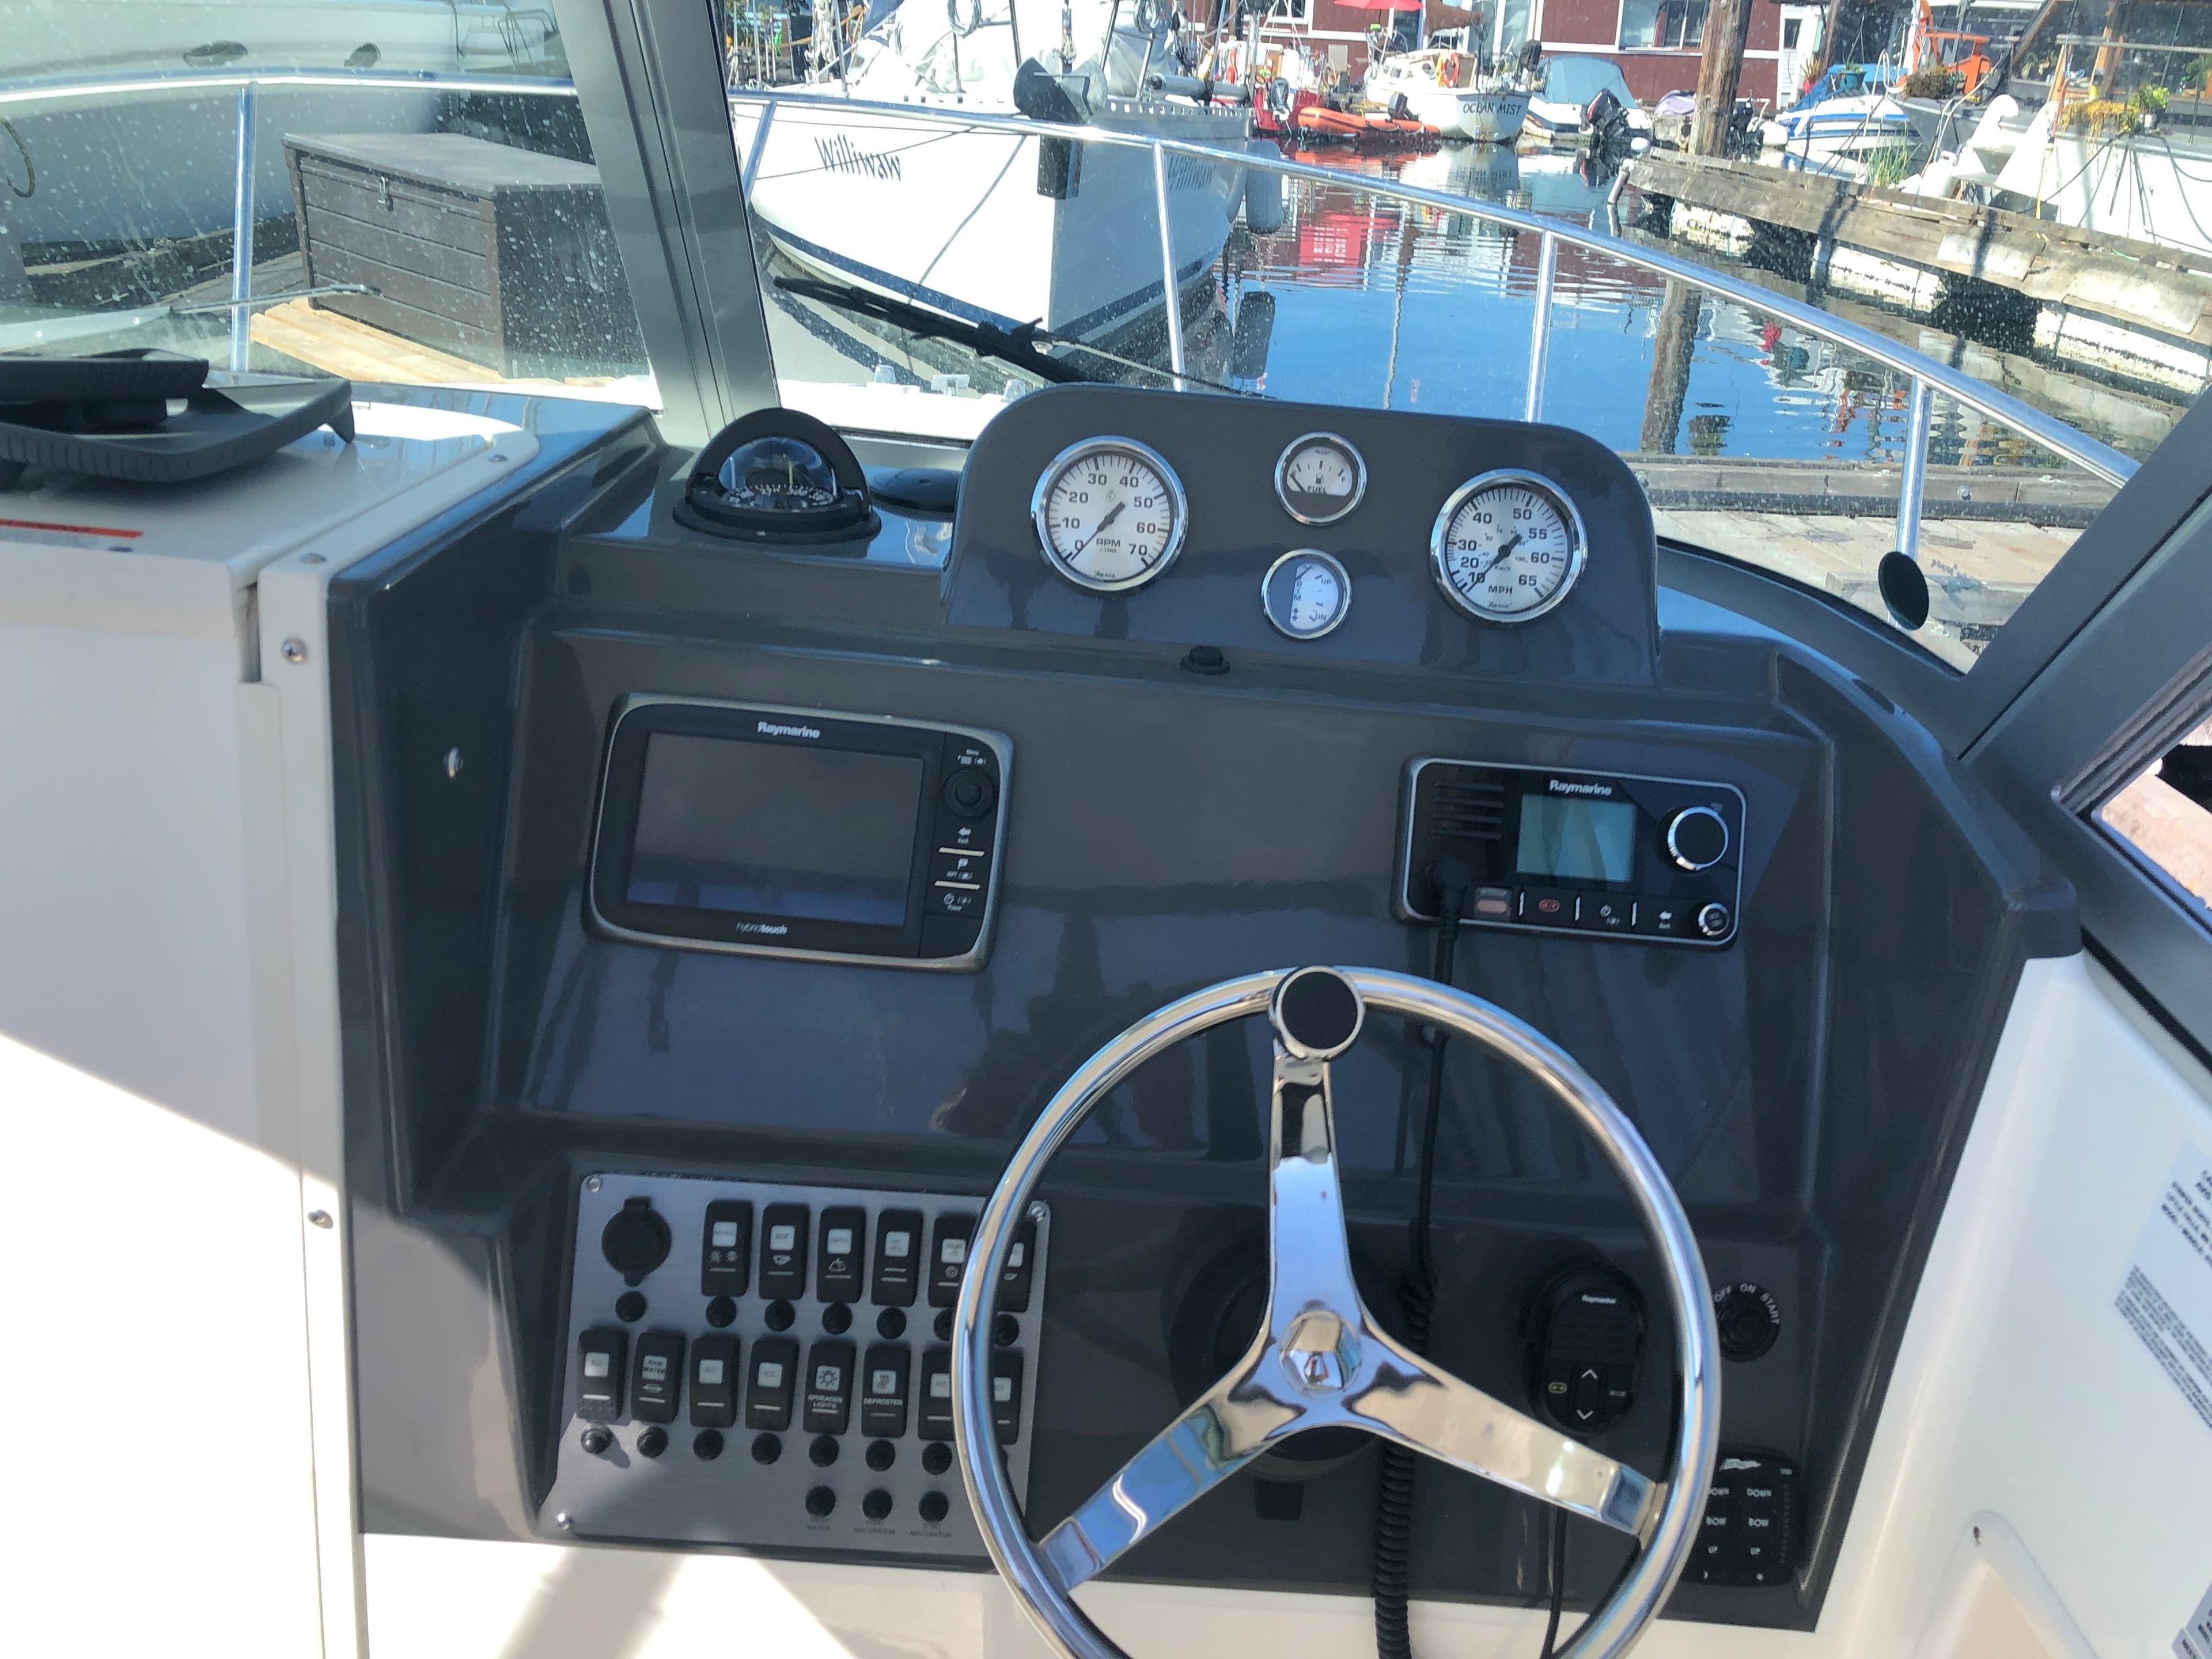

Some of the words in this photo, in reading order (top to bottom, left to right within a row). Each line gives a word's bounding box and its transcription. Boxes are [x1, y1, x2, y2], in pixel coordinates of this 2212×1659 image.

[1463, 102, 1494, 113] OCEAN
[1497, 103, 1521, 115] MIST
[815, 133, 902, 182] Williwaw
[1088, 474, 1107, 485] 30
[1119, 476, 1139, 487] 40
[1069, 492, 1088, 503] 20
[1134, 497, 1153, 508] 50
[1473, 513, 1493, 524] 40
[1513, 508, 1532, 520] 50
[1062, 517, 1080, 529] 10
[1137, 522, 1156, 533] 60
[1529, 528, 1547, 540] 55
[1075, 540, 1084, 550] 0
[1096, 538, 1120, 548] RPM
[1457, 540, 1477, 551] 30
[1128, 544, 1147, 556] 70
[1460, 557, 1479, 568] 20
[1531, 552, 1550, 563] 60
[1469, 572, 1485, 583] 10
[1518, 575, 1537, 586] 65
[1488, 585, 1513, 594] MPH
[757, 721, 820, 738] Raymarine
[1550, 779, 1612, 796] Raymarine
[1740, 1283, 1757, 1294] ON
[1760, 1293, 1780, 1324] START
[864, 1397, 903, 1406] DEFROSTER
[1747, 1488, 1771, 1498] DOWN
[1706, 1516, 1727, 1526] BOW
[1748, 1517, 1769, 1527] BOW
[1708, 1546, 1718, 1554] UP
[1750, 1547, 1761, 1555] UP
